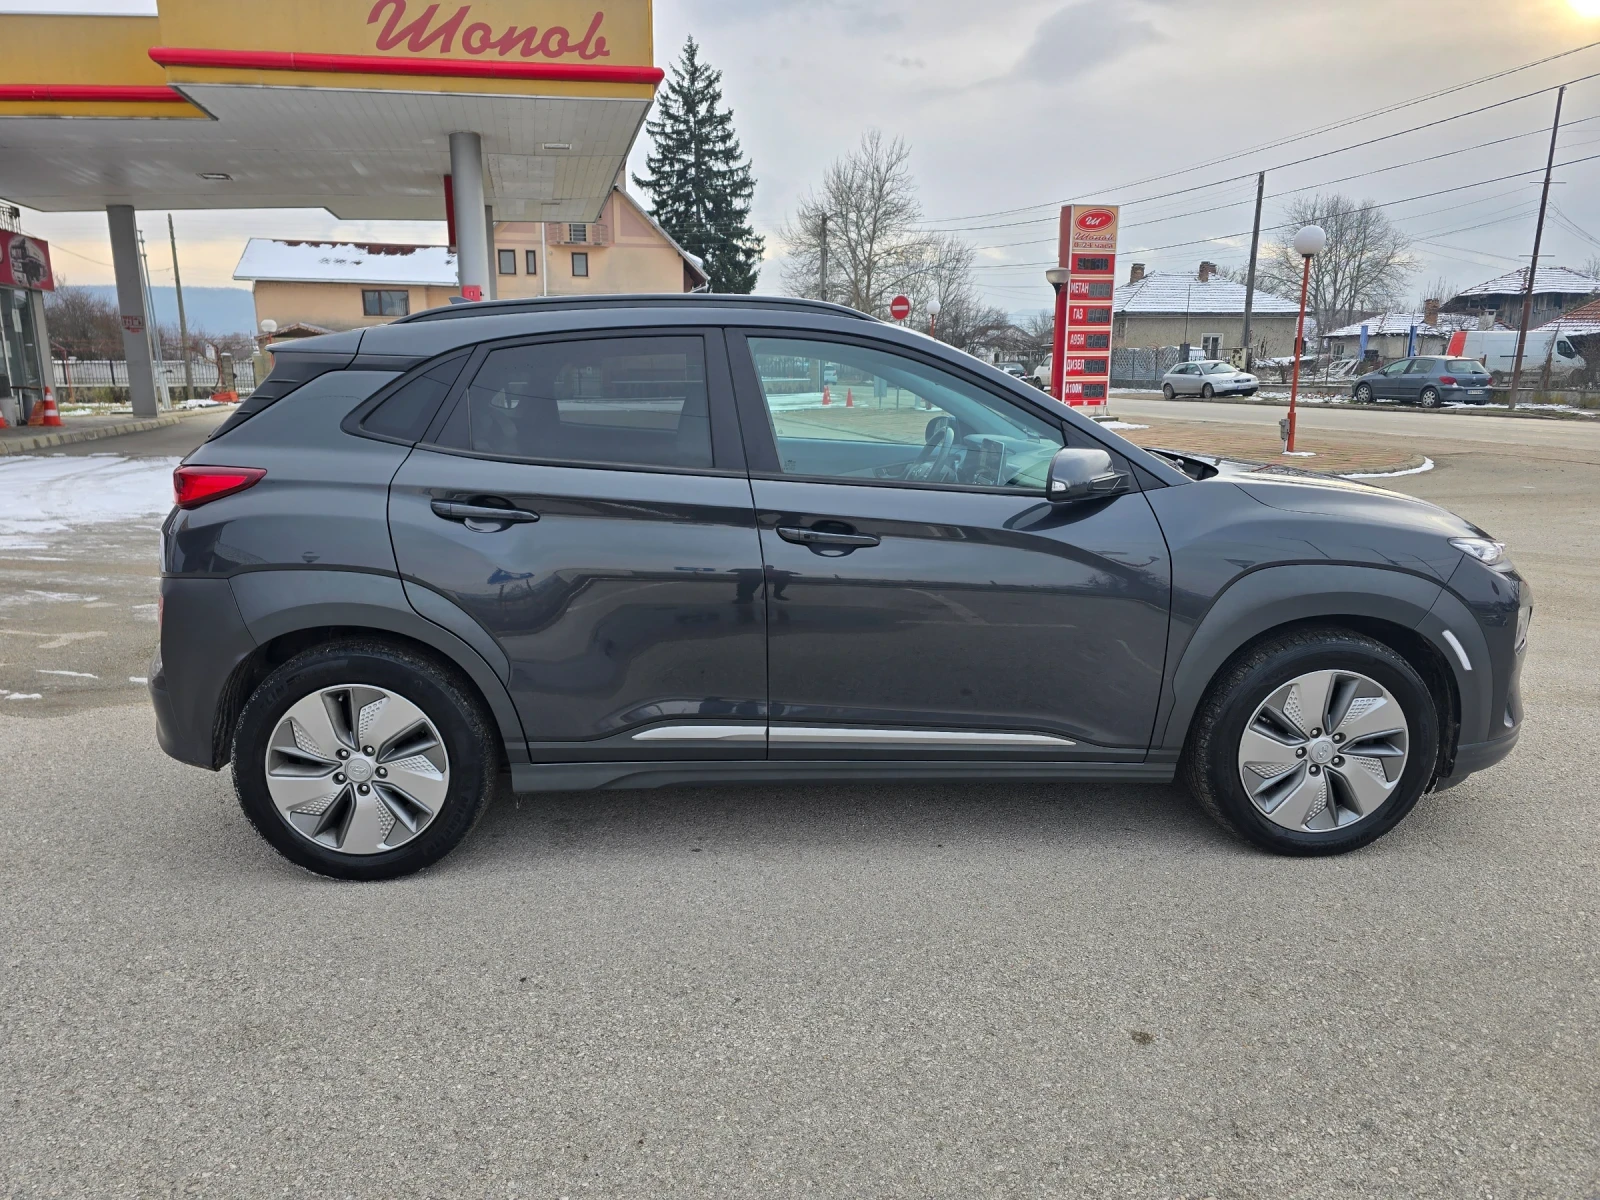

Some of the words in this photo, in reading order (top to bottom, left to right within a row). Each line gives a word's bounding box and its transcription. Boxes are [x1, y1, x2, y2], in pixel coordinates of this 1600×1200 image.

[1070, 283, 1089, 293] МЕТАН
[1073, 308, 1083, 319] ГАЗ
[1066, 359, 1084, 371] ДИЗЕЛ
